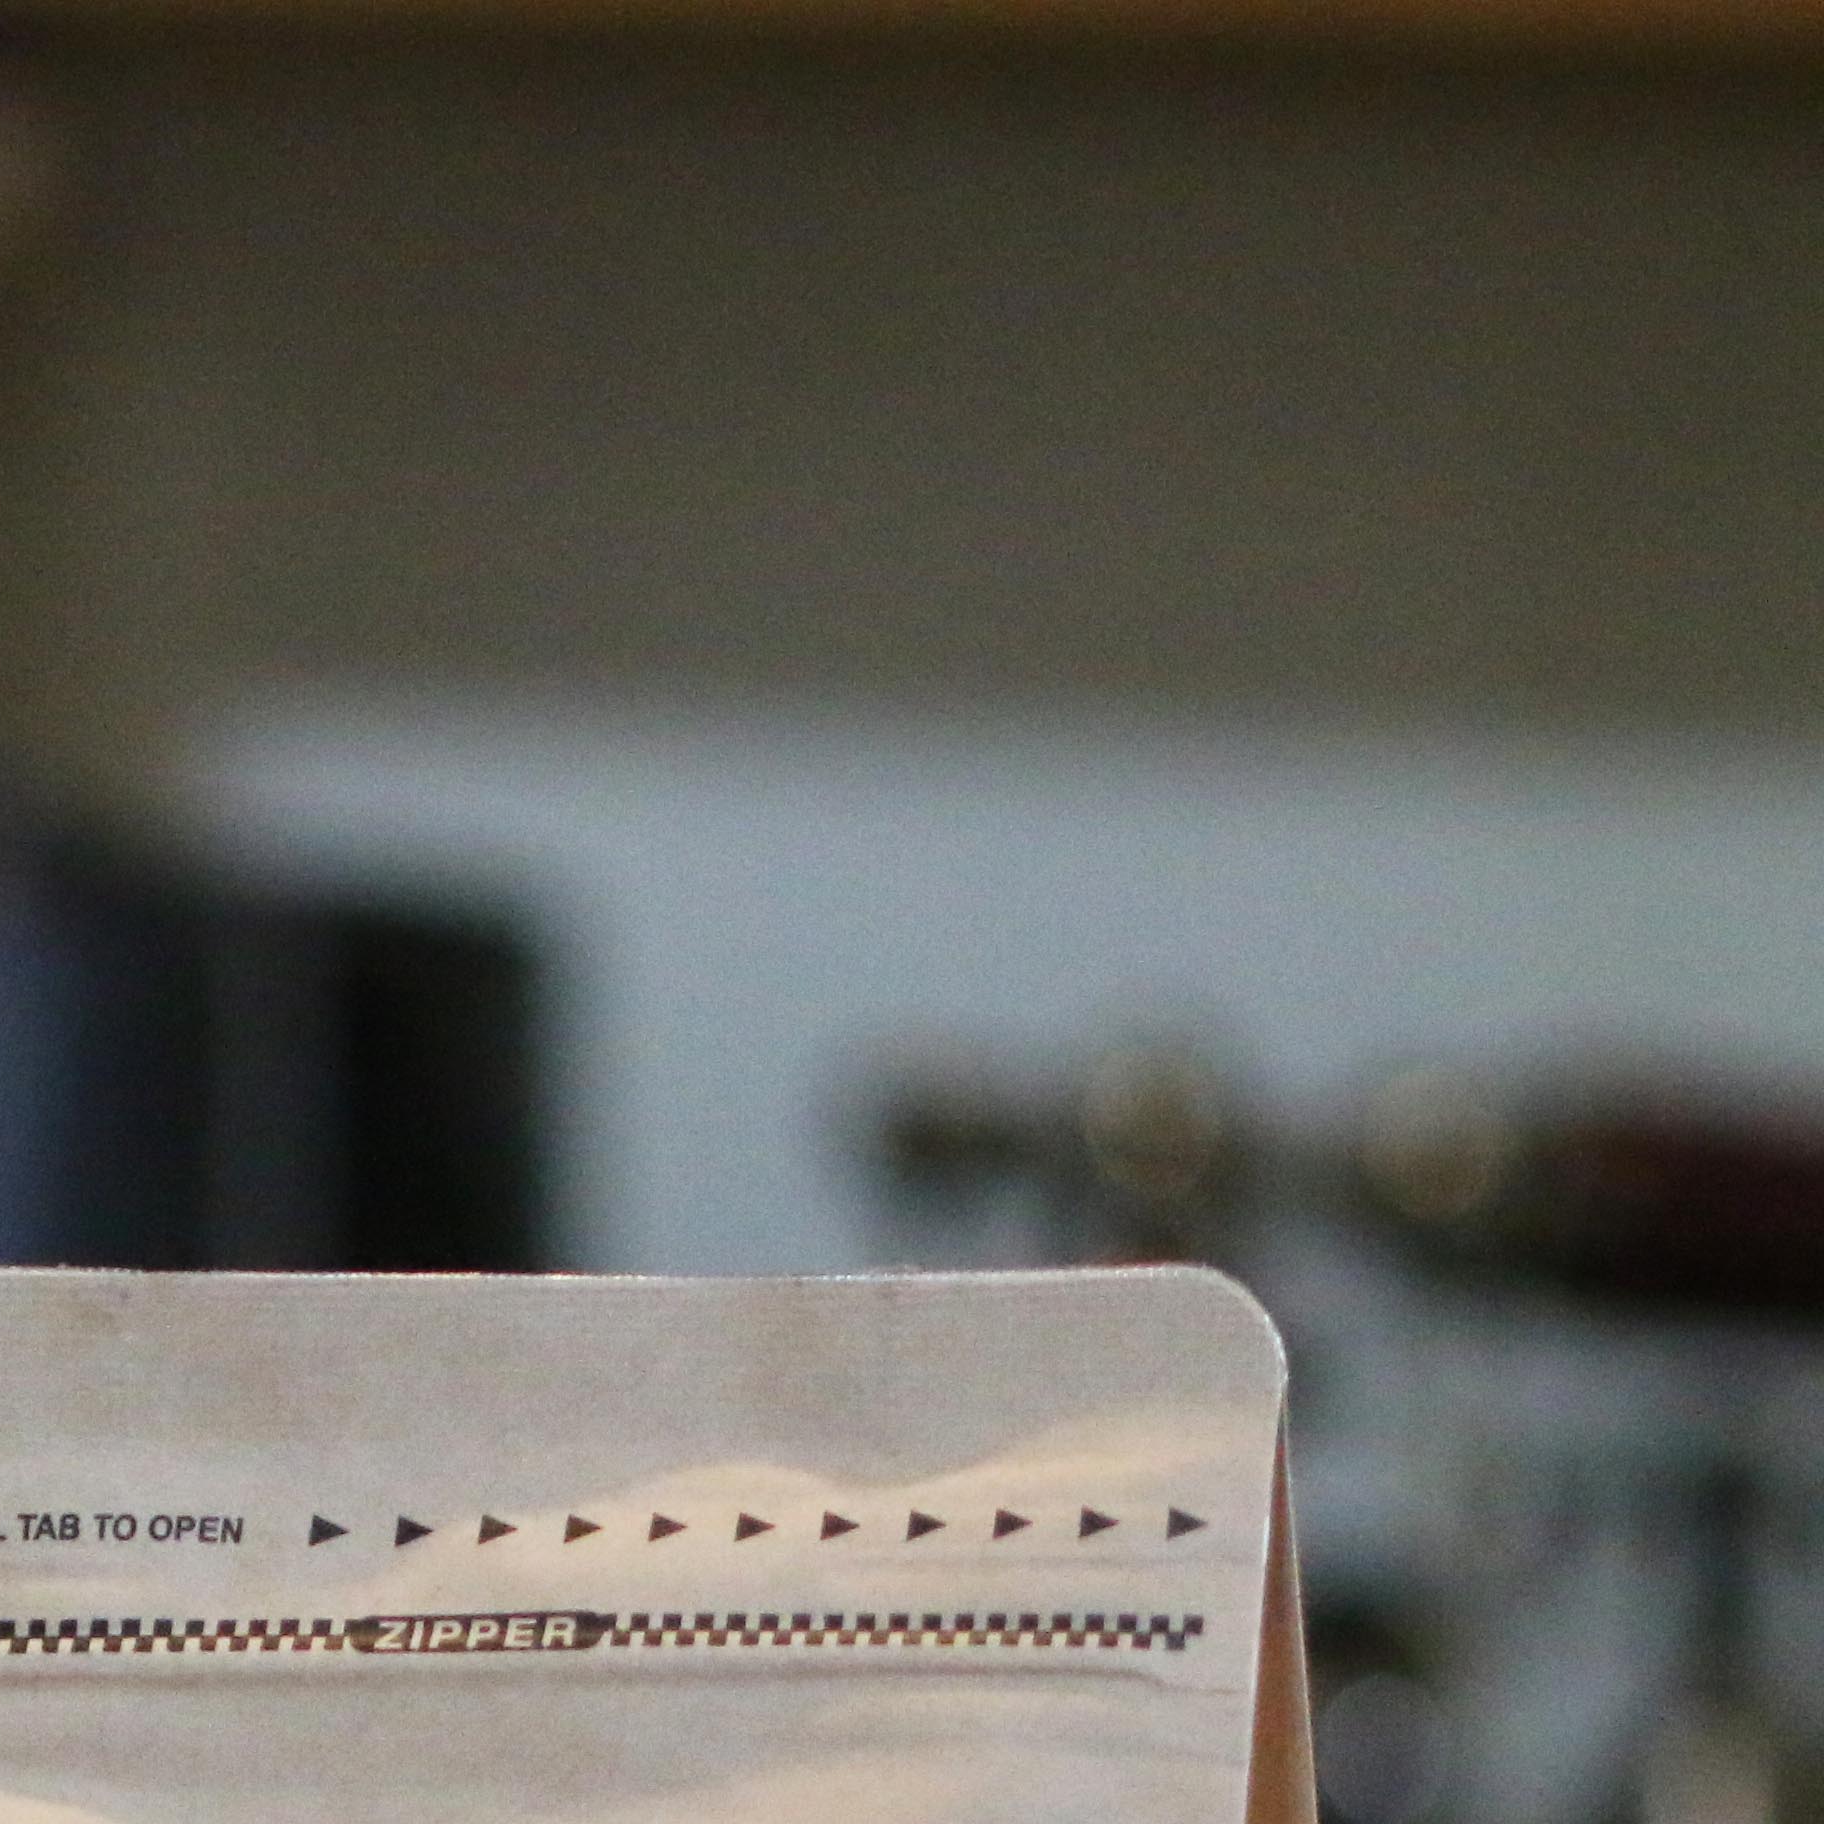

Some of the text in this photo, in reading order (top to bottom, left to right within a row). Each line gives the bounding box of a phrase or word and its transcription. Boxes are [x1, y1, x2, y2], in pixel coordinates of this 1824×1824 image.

[18, 1513, 80, 1541] TAB
[94, 1513, 137, 1541] TO
[148, 1514, 244, 1545] OPEN
[374, 1616, 577, 1649] ZIPPER
